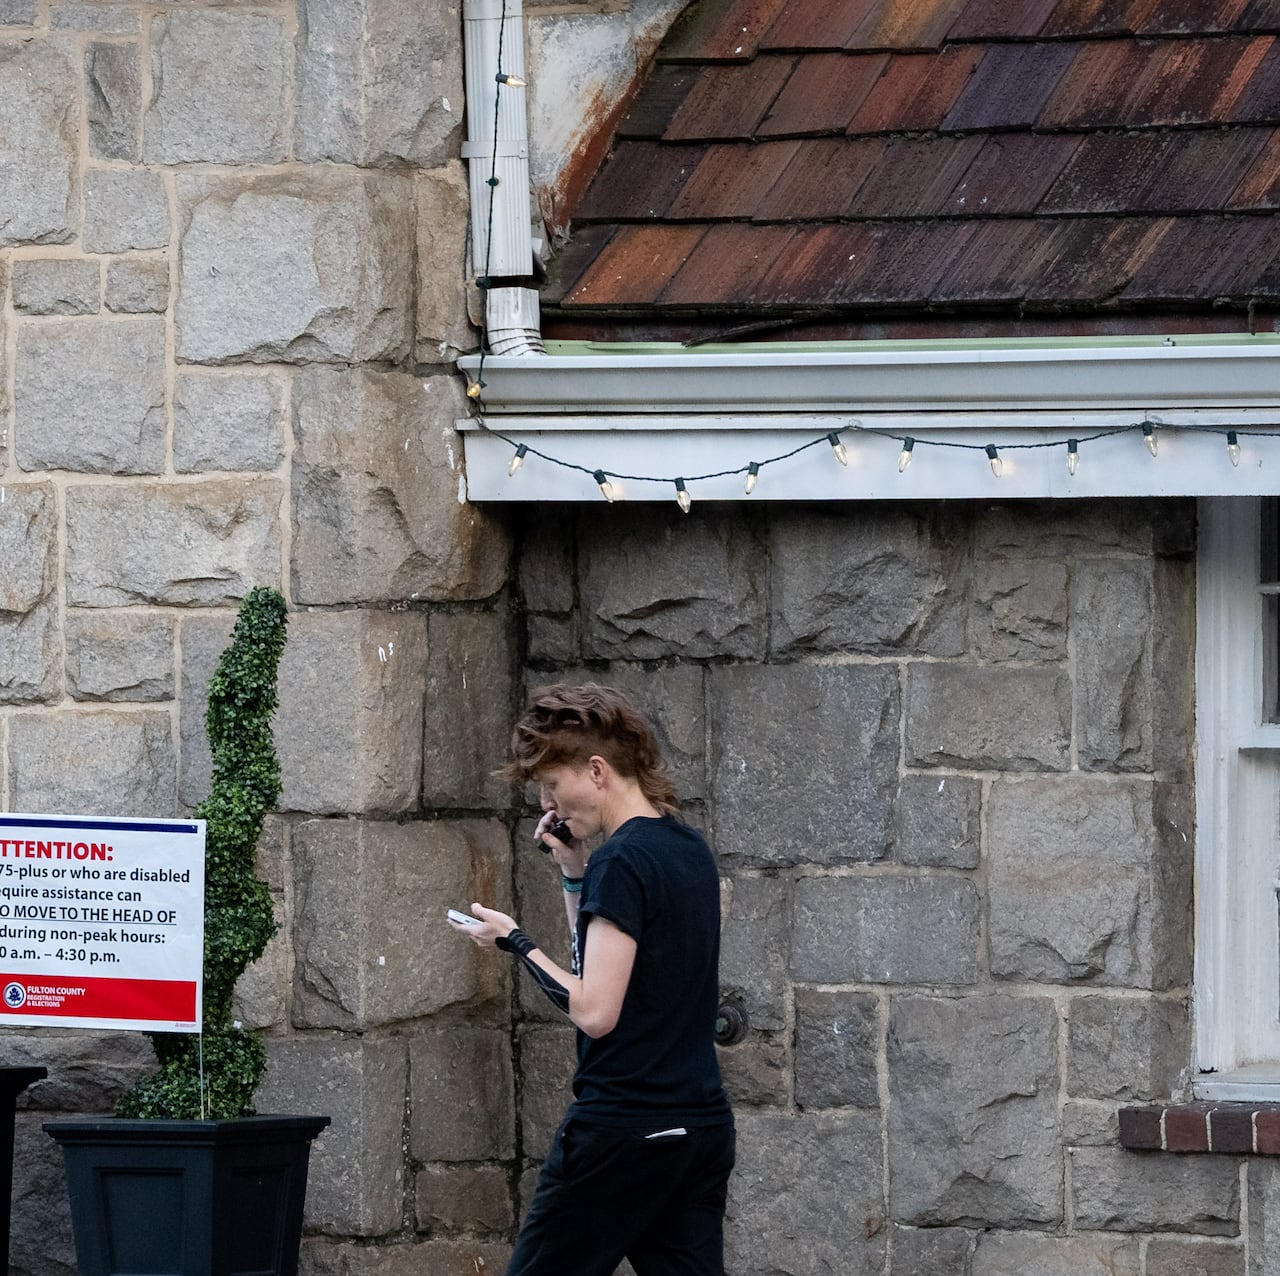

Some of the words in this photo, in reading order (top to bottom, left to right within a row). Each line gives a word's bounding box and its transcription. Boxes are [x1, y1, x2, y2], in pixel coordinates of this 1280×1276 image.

[51, 868, 67, 879] or
[70, 866, 101, 880] who
[104, 870, 127, 881] are
[130, 868, 190, 883] disabled
[42, 886, 114, 900] assistance
[117, 891, 142, 901] can
[13, 905, 57, 919] MOVE
[59, 906, 78, 920] TO
[80, 908, 109, 921] THE
[112, 909, 153, 922] HEAD
[157, 910, 177, 923] OF
[50, 929, 117, 944] non-peak
[121, 929, 166, 943] hours:
[10, 949, 41, 960] a.m.
[55, 948, 86, 961] 4:30
[90, 951, 120, 964] p.m.
[27, 985, 55, 995] FULTON
[56, 987, 86, 996] COUNTY
[27, 994, 65, 1002] REGISTRATION
